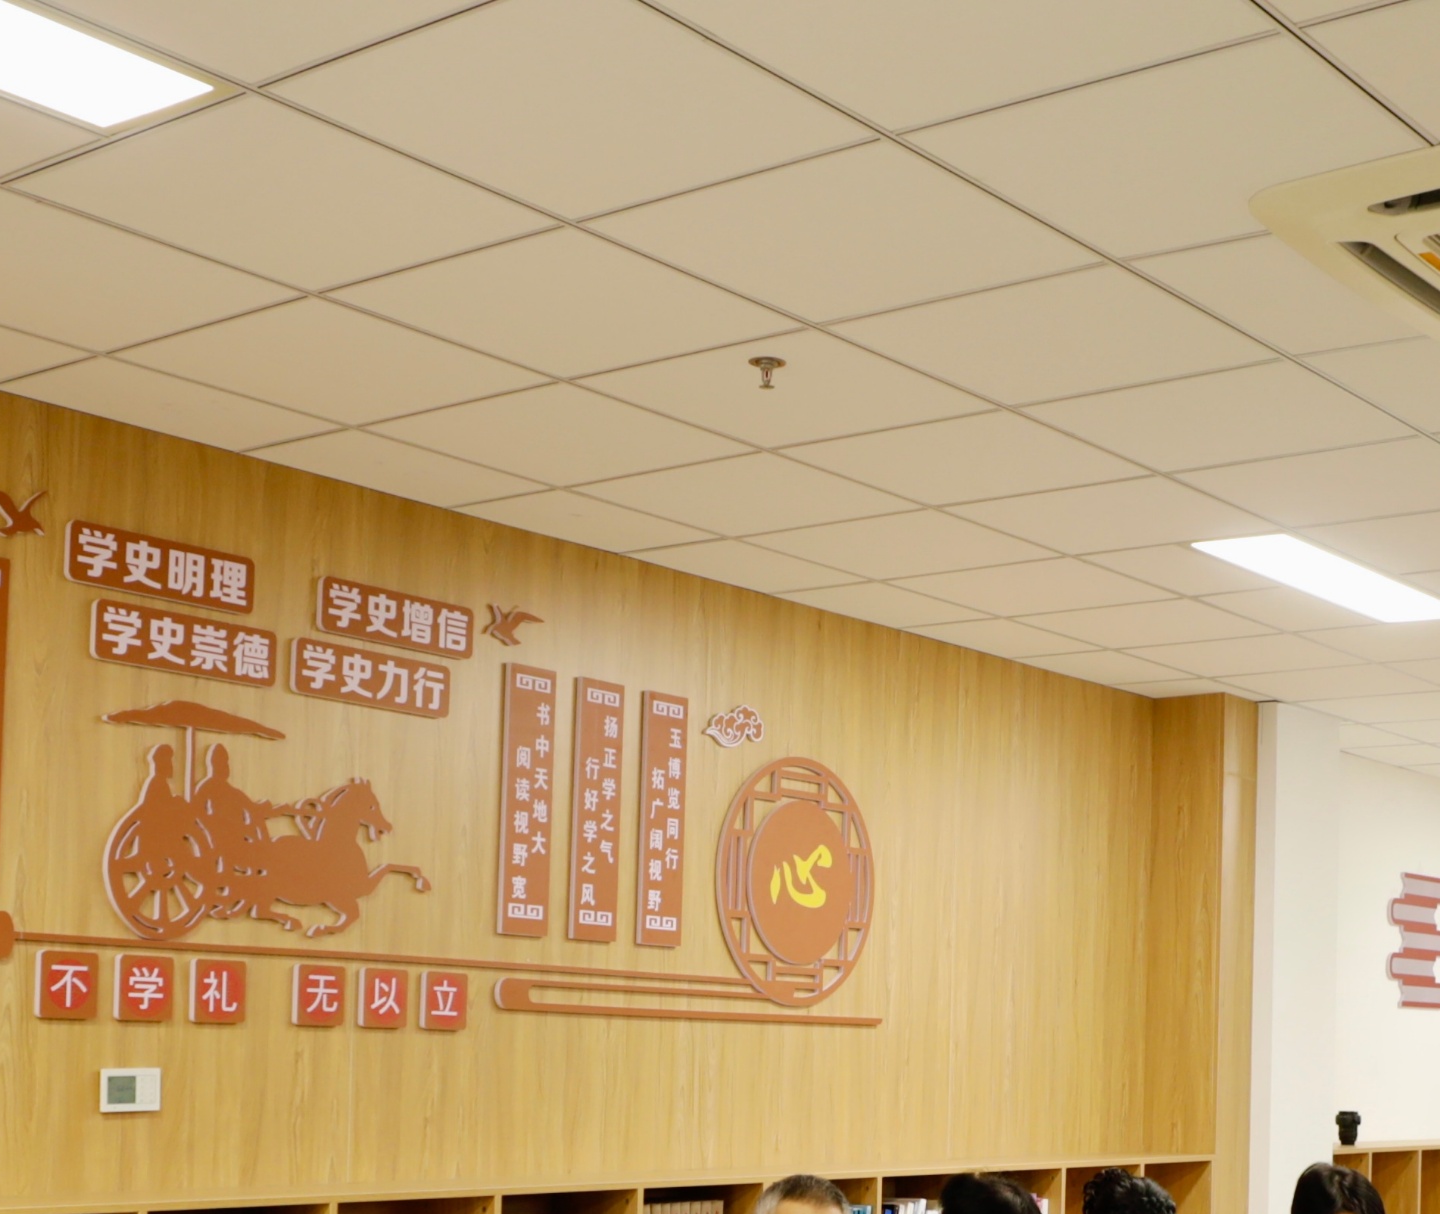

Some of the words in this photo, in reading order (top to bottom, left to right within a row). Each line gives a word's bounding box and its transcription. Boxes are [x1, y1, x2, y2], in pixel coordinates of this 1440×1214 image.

[77, 527, 249, 606] 学史明理
[326, 583, 469, 653] 学史增信
[101, 606, 271, 680] 学史崇德
[301, 644, 447, 712] 学史力行
[511, 745, 532, 900] 阅读视野宽
[531, 702, 552, 855] 书中天地大
[580, 756, 600, 907] 行好学之风
[599, 715, 619, 864] 扬正学之气
[665, 727, 683, 871] 玉博览同行
[647, 767, 666, 913] 拓广阔视野
[768, 843, 834, 909] 心
[49, 962, 239, 1016] 不学礼
[305, 971, 459, 1019] 无以立
